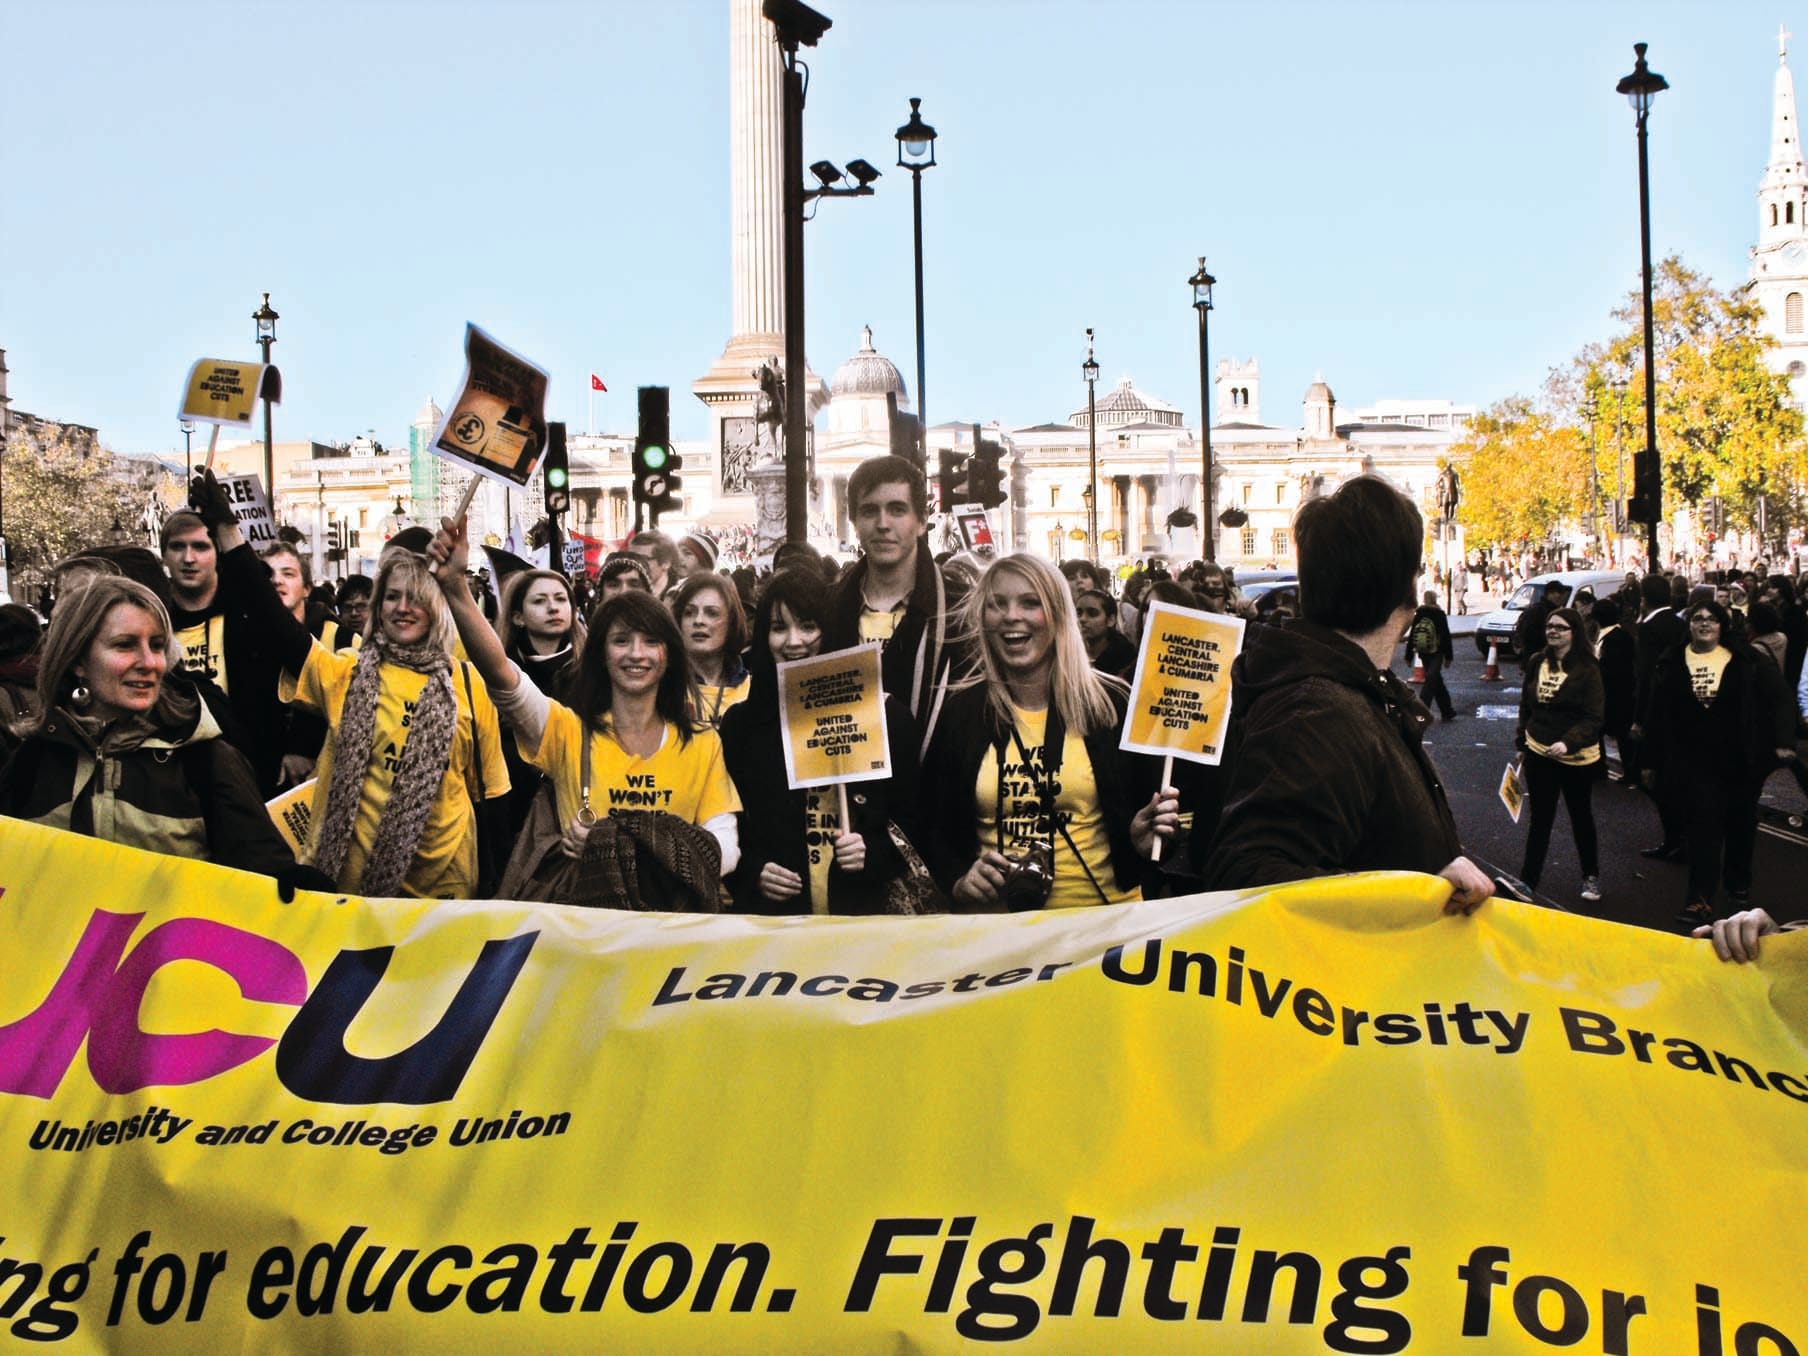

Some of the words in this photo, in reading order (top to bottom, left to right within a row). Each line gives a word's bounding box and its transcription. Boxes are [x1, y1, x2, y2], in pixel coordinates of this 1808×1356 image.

[200, 381, 244, 395] EDUCATION
[210, 392, 230, 402] CUTS
[218, 480, 256, 504] REE
[249, 523, 276, 542] ALL
[1167, 645, 1212, 661] CENTRAL
[1157, 653, 1220, 673] LANCASHIRE
[1167, 666, 1214, 682] CUMBRIA
[800, 683, 864, 703] LANCASHIRE
[809, 678, 854, 694] CENTRAL
[1163, 687, 1200, 700] UNITED
[814, 693, 862, 709] CUMBRIA
[1157, 697, 1203, 711] AGAINST
[816, 714, 853, 727] UNITED
[1149, 705, 1209, 724] EDUCATION
[813, 723, 859, 738] AGAINST
[1163, 718, 1190, 730] CUTS
[806, 732, 868, 749] EDUCATION
[825, 744, 852, 757] CUTS
[625, 773, 656, 789] WE
[608, 788, 673, 806] WON'T
[652, 966, 1073, 1006] Lancaster
[1101, 939, 1530, 1055] University
[1559, 1007, 1808, 1103] Branc
[28, 1108, 193, 1152] University
[195, 1120, 280, 1146] and
[281, 1119, 435, 1155] College
[449, 1111, 572, 1147] Union
[0, 1236, 100, 1342] ng
[105, 1230, 228, 1328] for
[246, 1221, 797, 1321] education.
[843, 1215, 1412, 1356] Fighting
[1458, 1246, 1647, 1356] for
